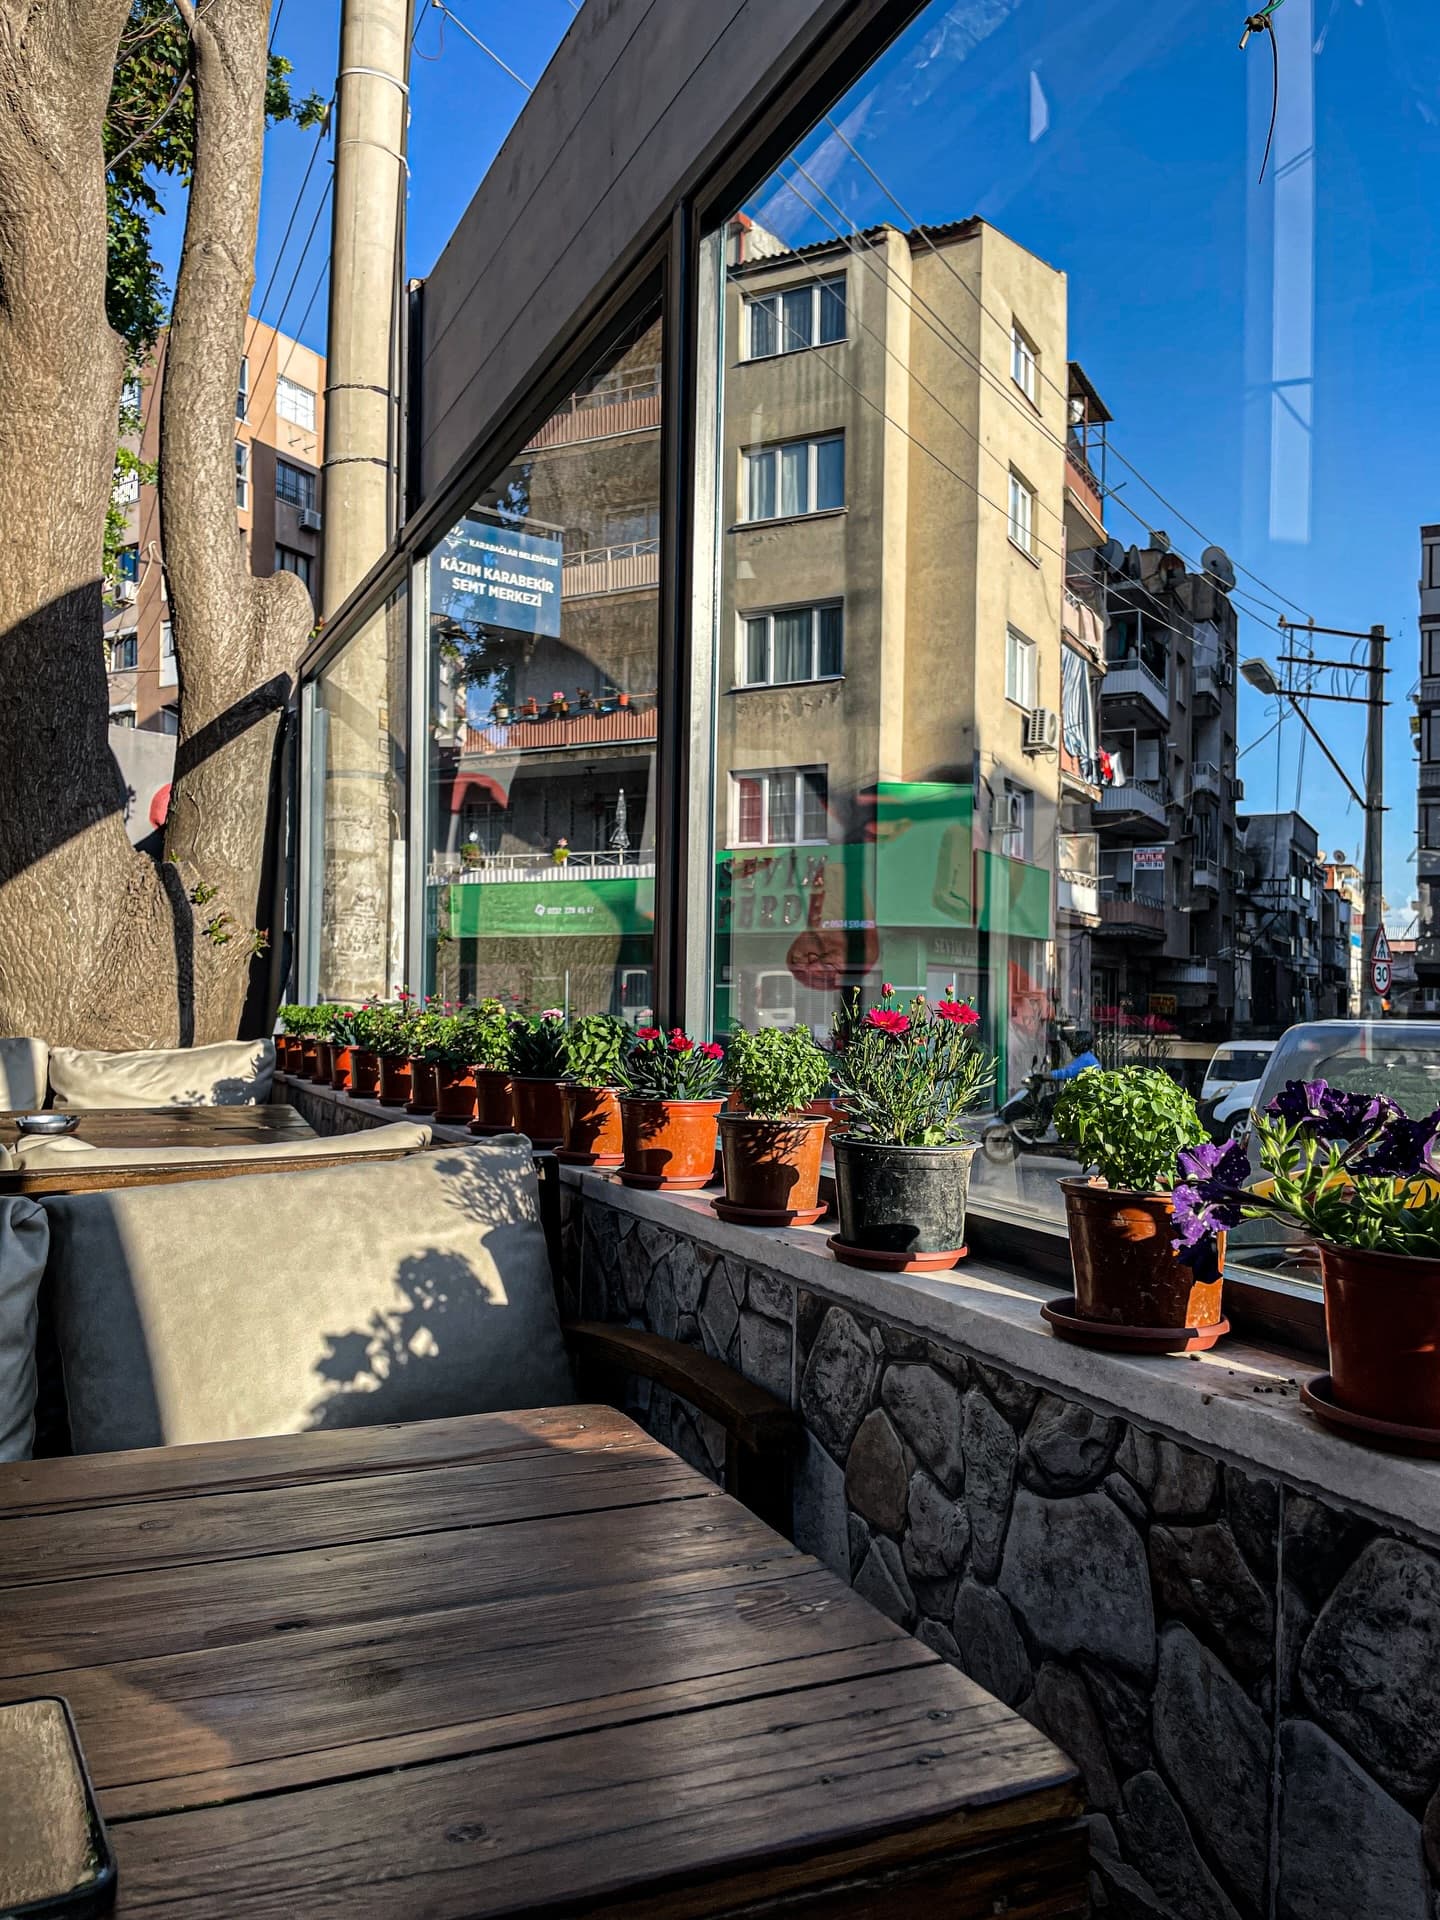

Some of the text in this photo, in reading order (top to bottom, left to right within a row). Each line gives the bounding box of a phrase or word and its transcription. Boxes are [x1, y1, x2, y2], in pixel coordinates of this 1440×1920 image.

[440, 557, 555, 594] KÂZIM KARABEKİR
[452, 577, 542, 608] SEMT MERKEZİ
[1376, 966, 1388, 982] 30
